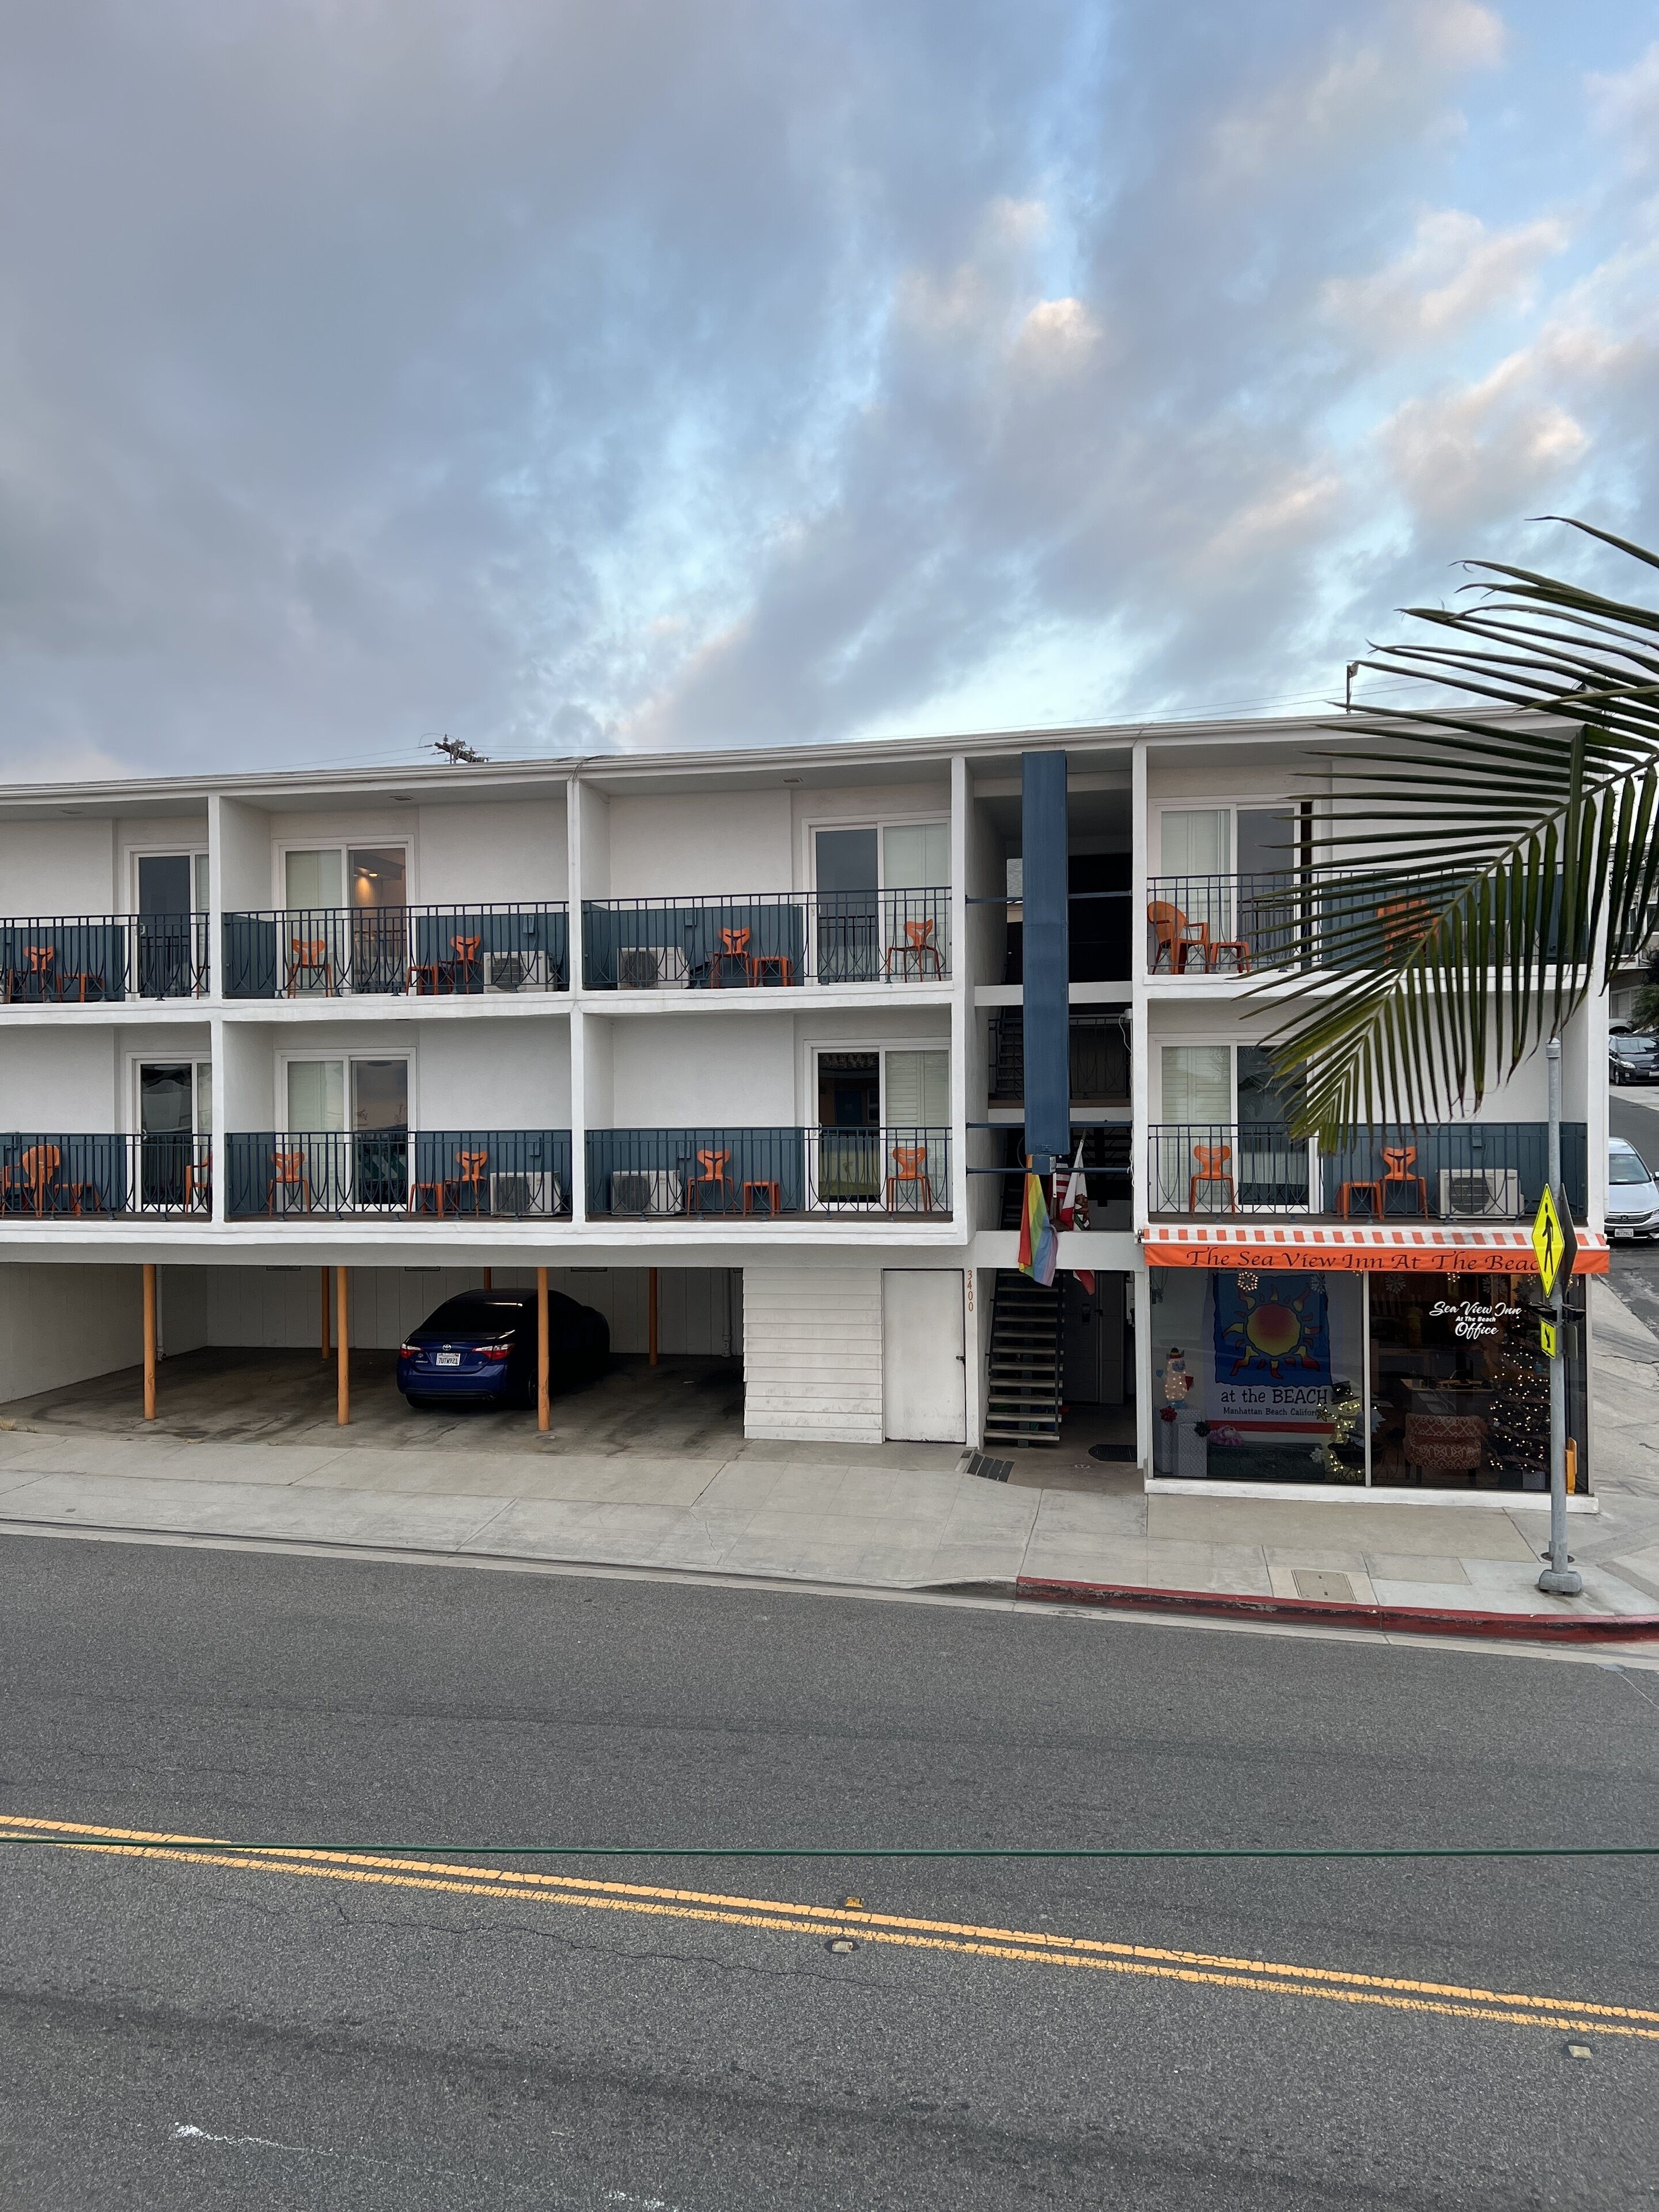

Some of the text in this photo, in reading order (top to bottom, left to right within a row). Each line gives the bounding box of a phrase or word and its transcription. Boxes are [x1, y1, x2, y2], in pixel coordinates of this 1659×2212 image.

[1187, 1247, 1539, 1271] The Sea View Inn At The Beac
[1429, 1301, 1522, 1317] Sea View Inn
[1455, 1322, 1499, 1339] Office
[1221, 1388, 1328, 1404] at the BEACH
[1223, 1407, 1263, 1415] Manhattan
[1290, 1408, 1320, 1416] Califor
